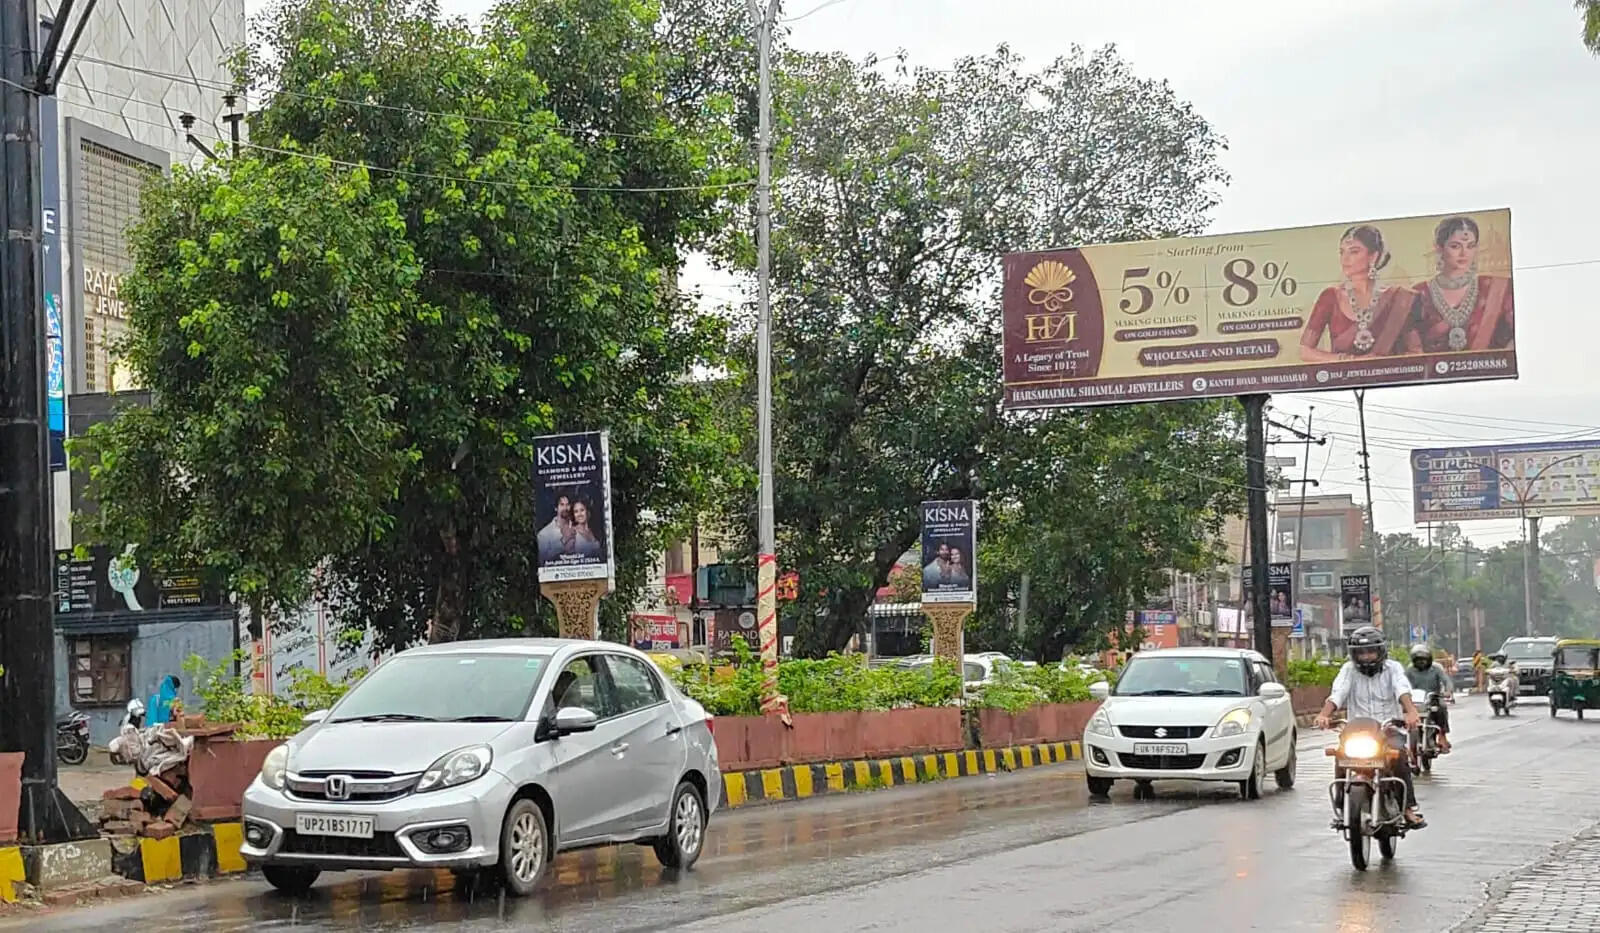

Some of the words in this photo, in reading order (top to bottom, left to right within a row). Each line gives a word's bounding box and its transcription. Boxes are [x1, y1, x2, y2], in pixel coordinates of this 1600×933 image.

[1166, 246, 1212, 258] Starting
[1213, 243, 1244, 255] from
[1223, 258, 1297, 307] 8%
[1119, 267, 1190, 315] 5%
[1217, 310, 1254, 320] MAKING
[1256, 306, 1303, 317] CHARGES
[1114, 318, 1150, 328] MAKING
[1152, 314, 1198, 325] CHARGES
[1222, 323, 1234, 332] ON
[1235, 322, 1256, 331] GOLD
[1257, 319, 1299, 330] JEWELLERY
[1124, 331, 1136, 339] ON
[1137, 329, 1158, 338] GOLD
[1159, 328, 1187, 337] CHAINS
[1014, 354, 1021, 363] A
[1023, 352, 1053, 364] Legacy
[1054, 351, 1064, 360] of
[1066, 350, 1089, 359] Trust
[1144, 348, 1209, 361] WHOLESALE
[1211, 346, 1233, 357] AND
[1236, 343, 1275, 355] RETAIL
[1028, 363, 1052, 372] Since
[1054, 361, 1077, 370] 1912
[1127, 380, 1184, 394] JEWELLERS
[1208, 378, 1235, 388] KANTH
[1261, 373, 1308, 384] MORADABAD
[537, 442, 596, 466] KISNA
[925, 507, 969, 521] KISNA
[1268, 565, 1290, 576] SNA
[1342, 577, 1369, 586] KISNA
[304, 817, 372, 838] UP21BS1717
